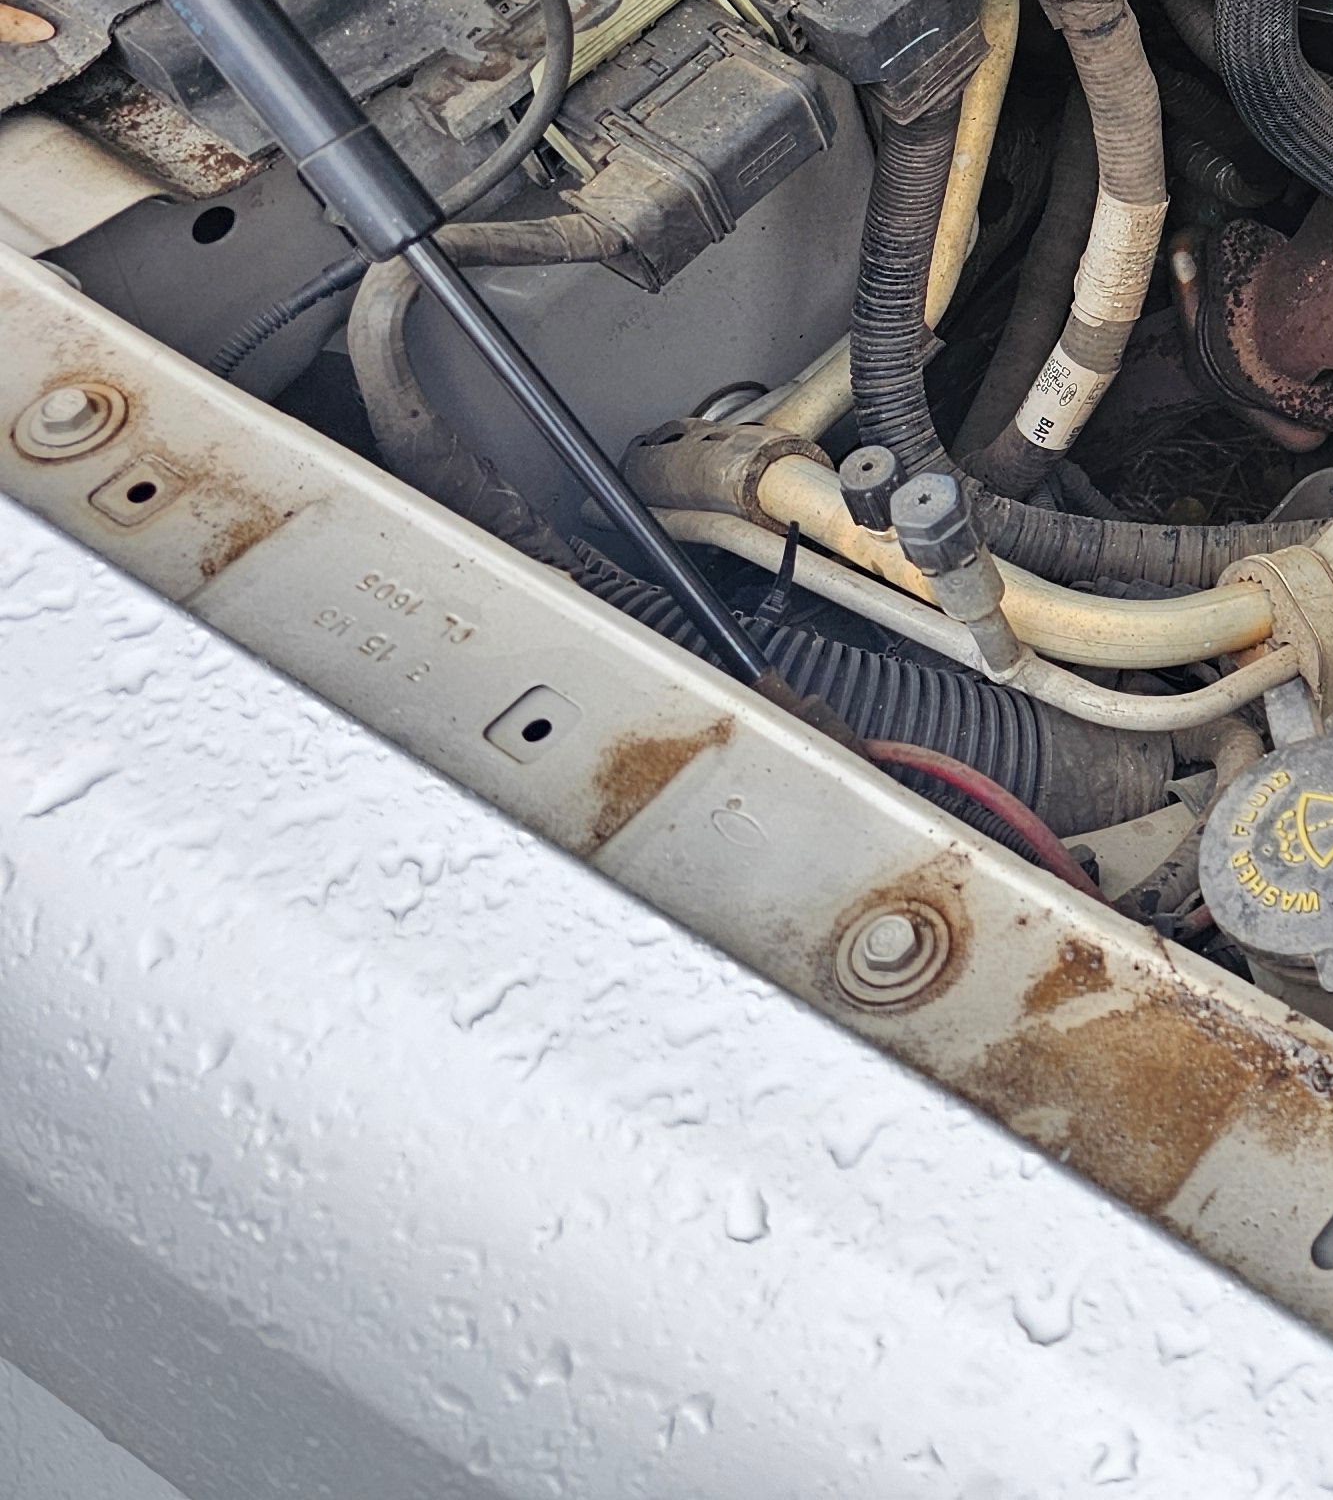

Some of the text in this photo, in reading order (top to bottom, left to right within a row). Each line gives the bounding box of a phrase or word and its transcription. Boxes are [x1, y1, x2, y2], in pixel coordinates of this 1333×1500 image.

[1039, 359, 1063, 395] 15525
[1049, 365, 1071, 396] CL3T
[1030, 416, 1054, 444] BAF
[1230, 770, 1320, 914] WASHER FLUID
